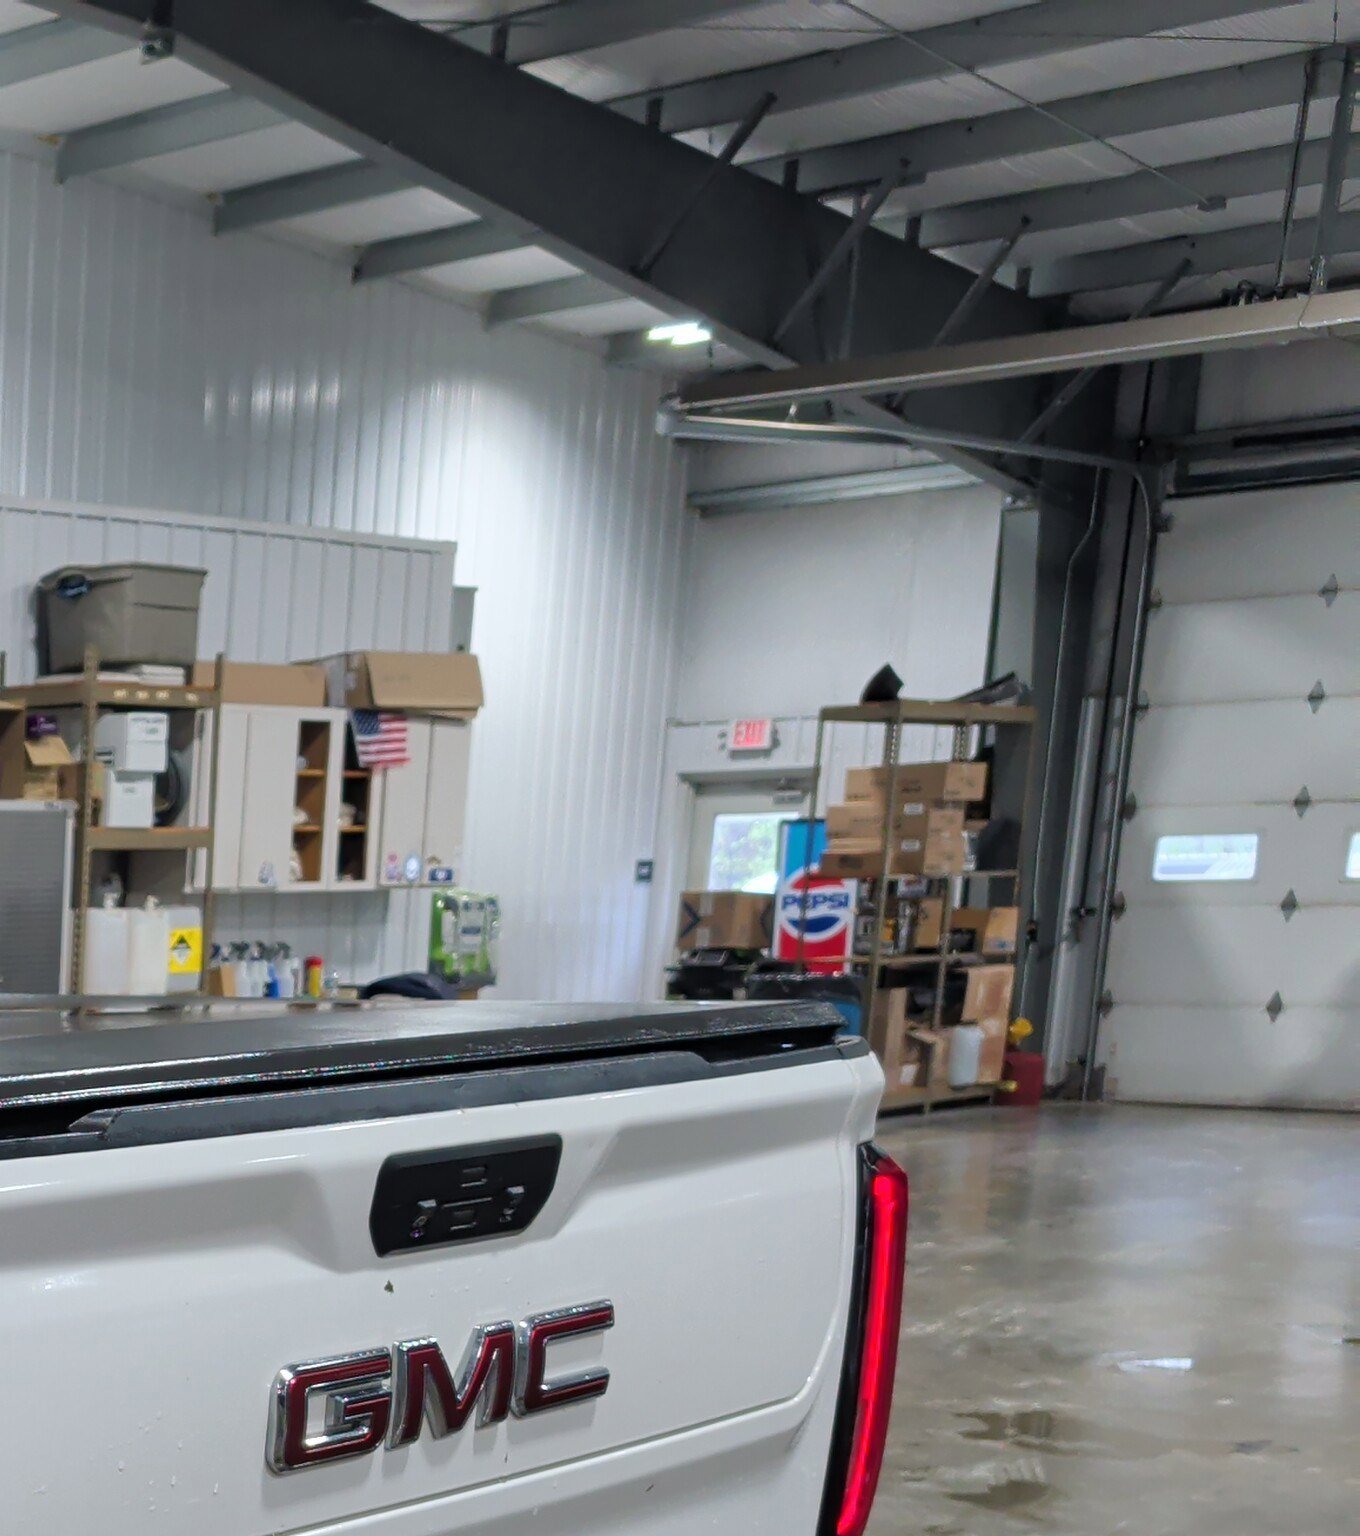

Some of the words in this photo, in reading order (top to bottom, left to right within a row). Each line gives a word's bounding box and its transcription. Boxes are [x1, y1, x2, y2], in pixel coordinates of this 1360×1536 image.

[733, 719, 767, 745] EXIT
[782, 892, 849, 911] PEPSI
[266, 1298, 615, 1477] GMC
